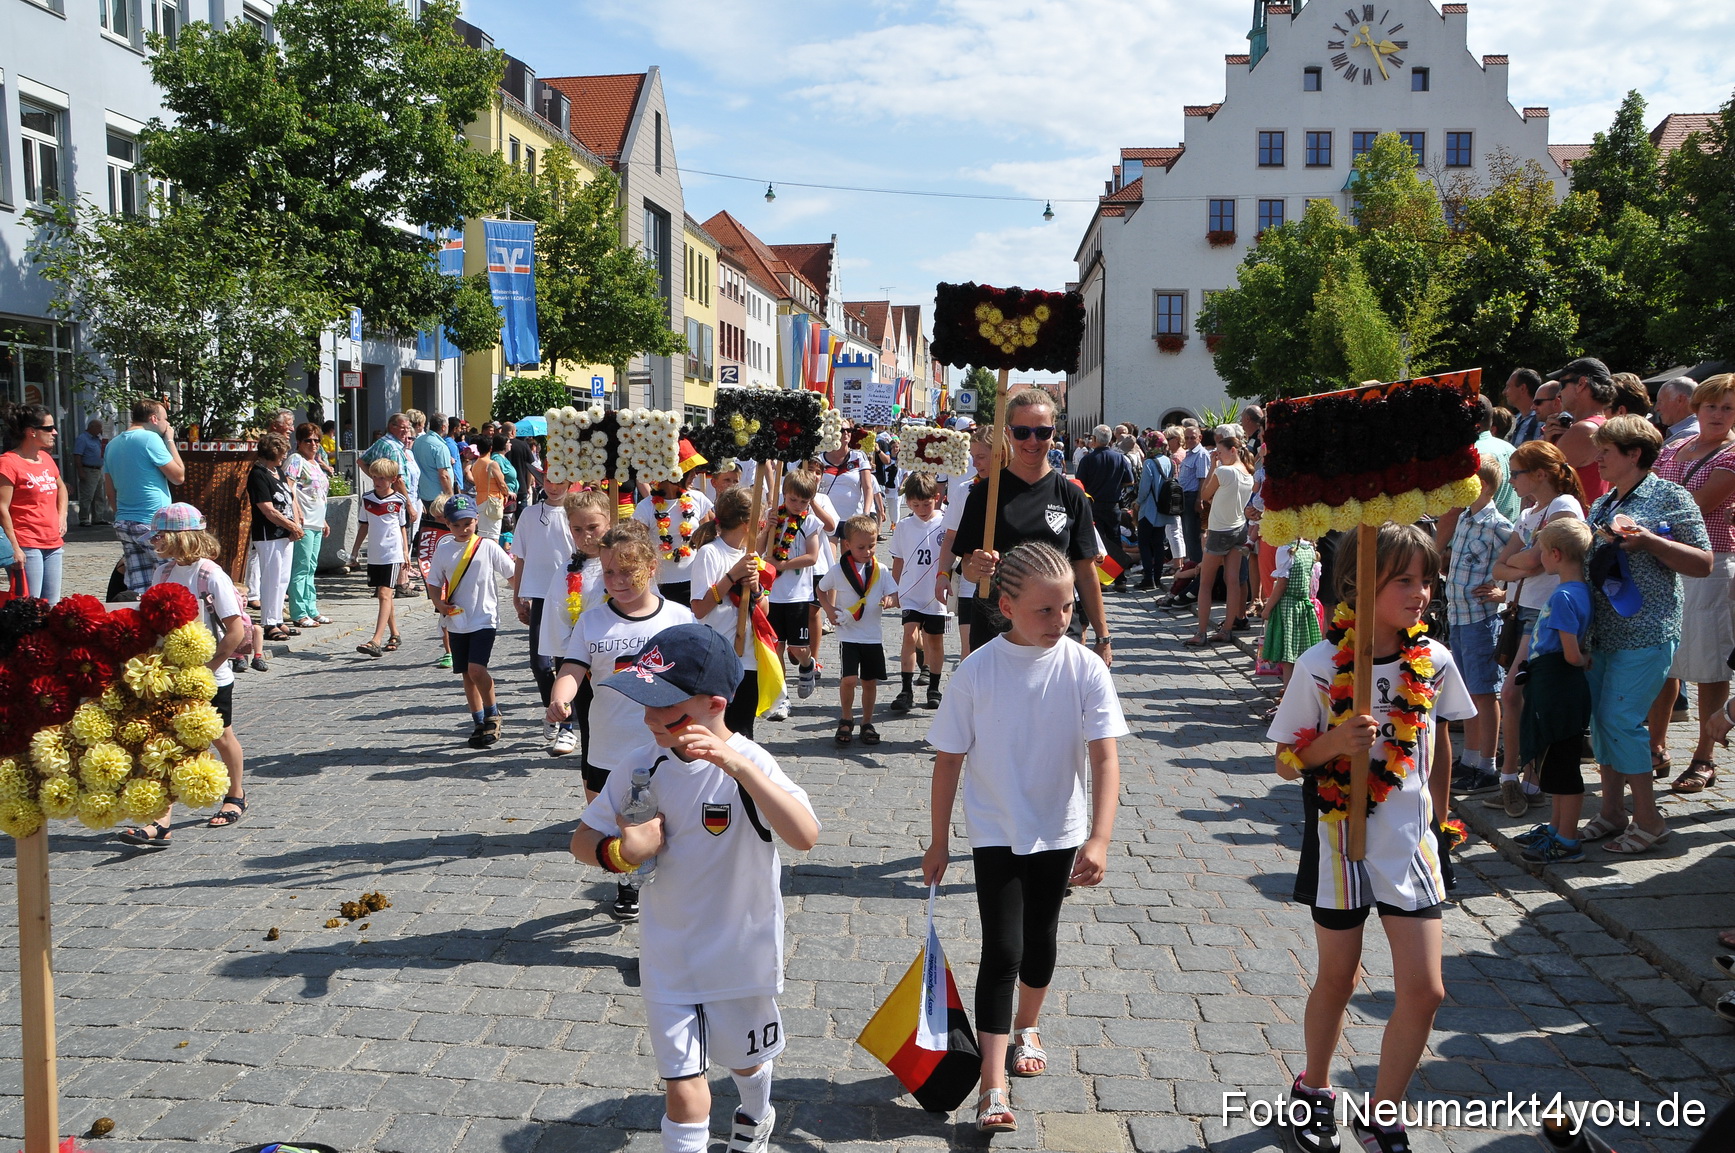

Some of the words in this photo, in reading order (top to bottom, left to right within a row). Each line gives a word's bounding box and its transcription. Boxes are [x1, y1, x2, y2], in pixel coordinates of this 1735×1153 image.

[353, 311, 359, 337] P
[593, 379, 602, 395] P
[917, 549, 932, 565] 23
[799, 627, 809, 640] 10
[746, 1021, 779, 1056] 10
